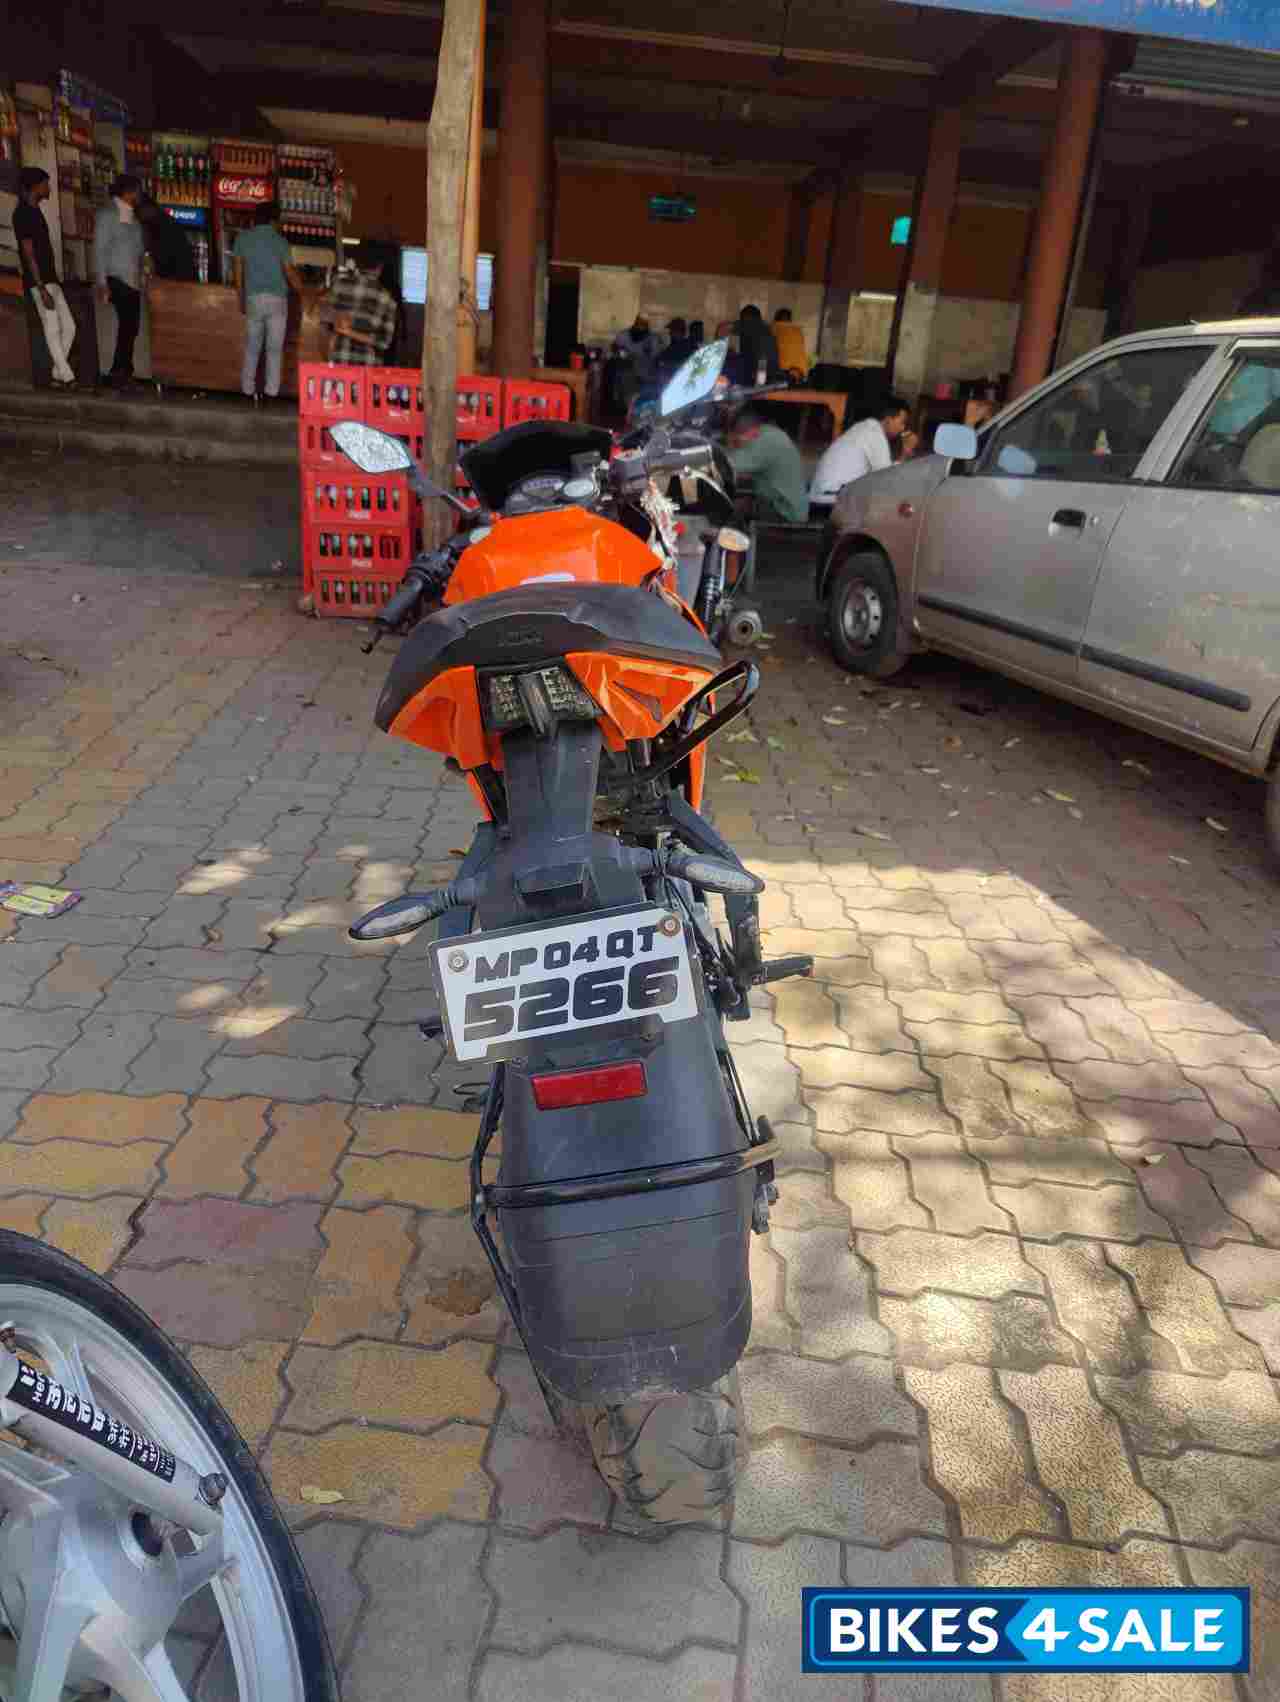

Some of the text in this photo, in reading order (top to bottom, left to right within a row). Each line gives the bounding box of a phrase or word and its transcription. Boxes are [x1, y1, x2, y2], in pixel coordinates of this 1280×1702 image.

[474, 925, 661, 984] MP 04 QT
[463, 956, 680, 1042] 5266
